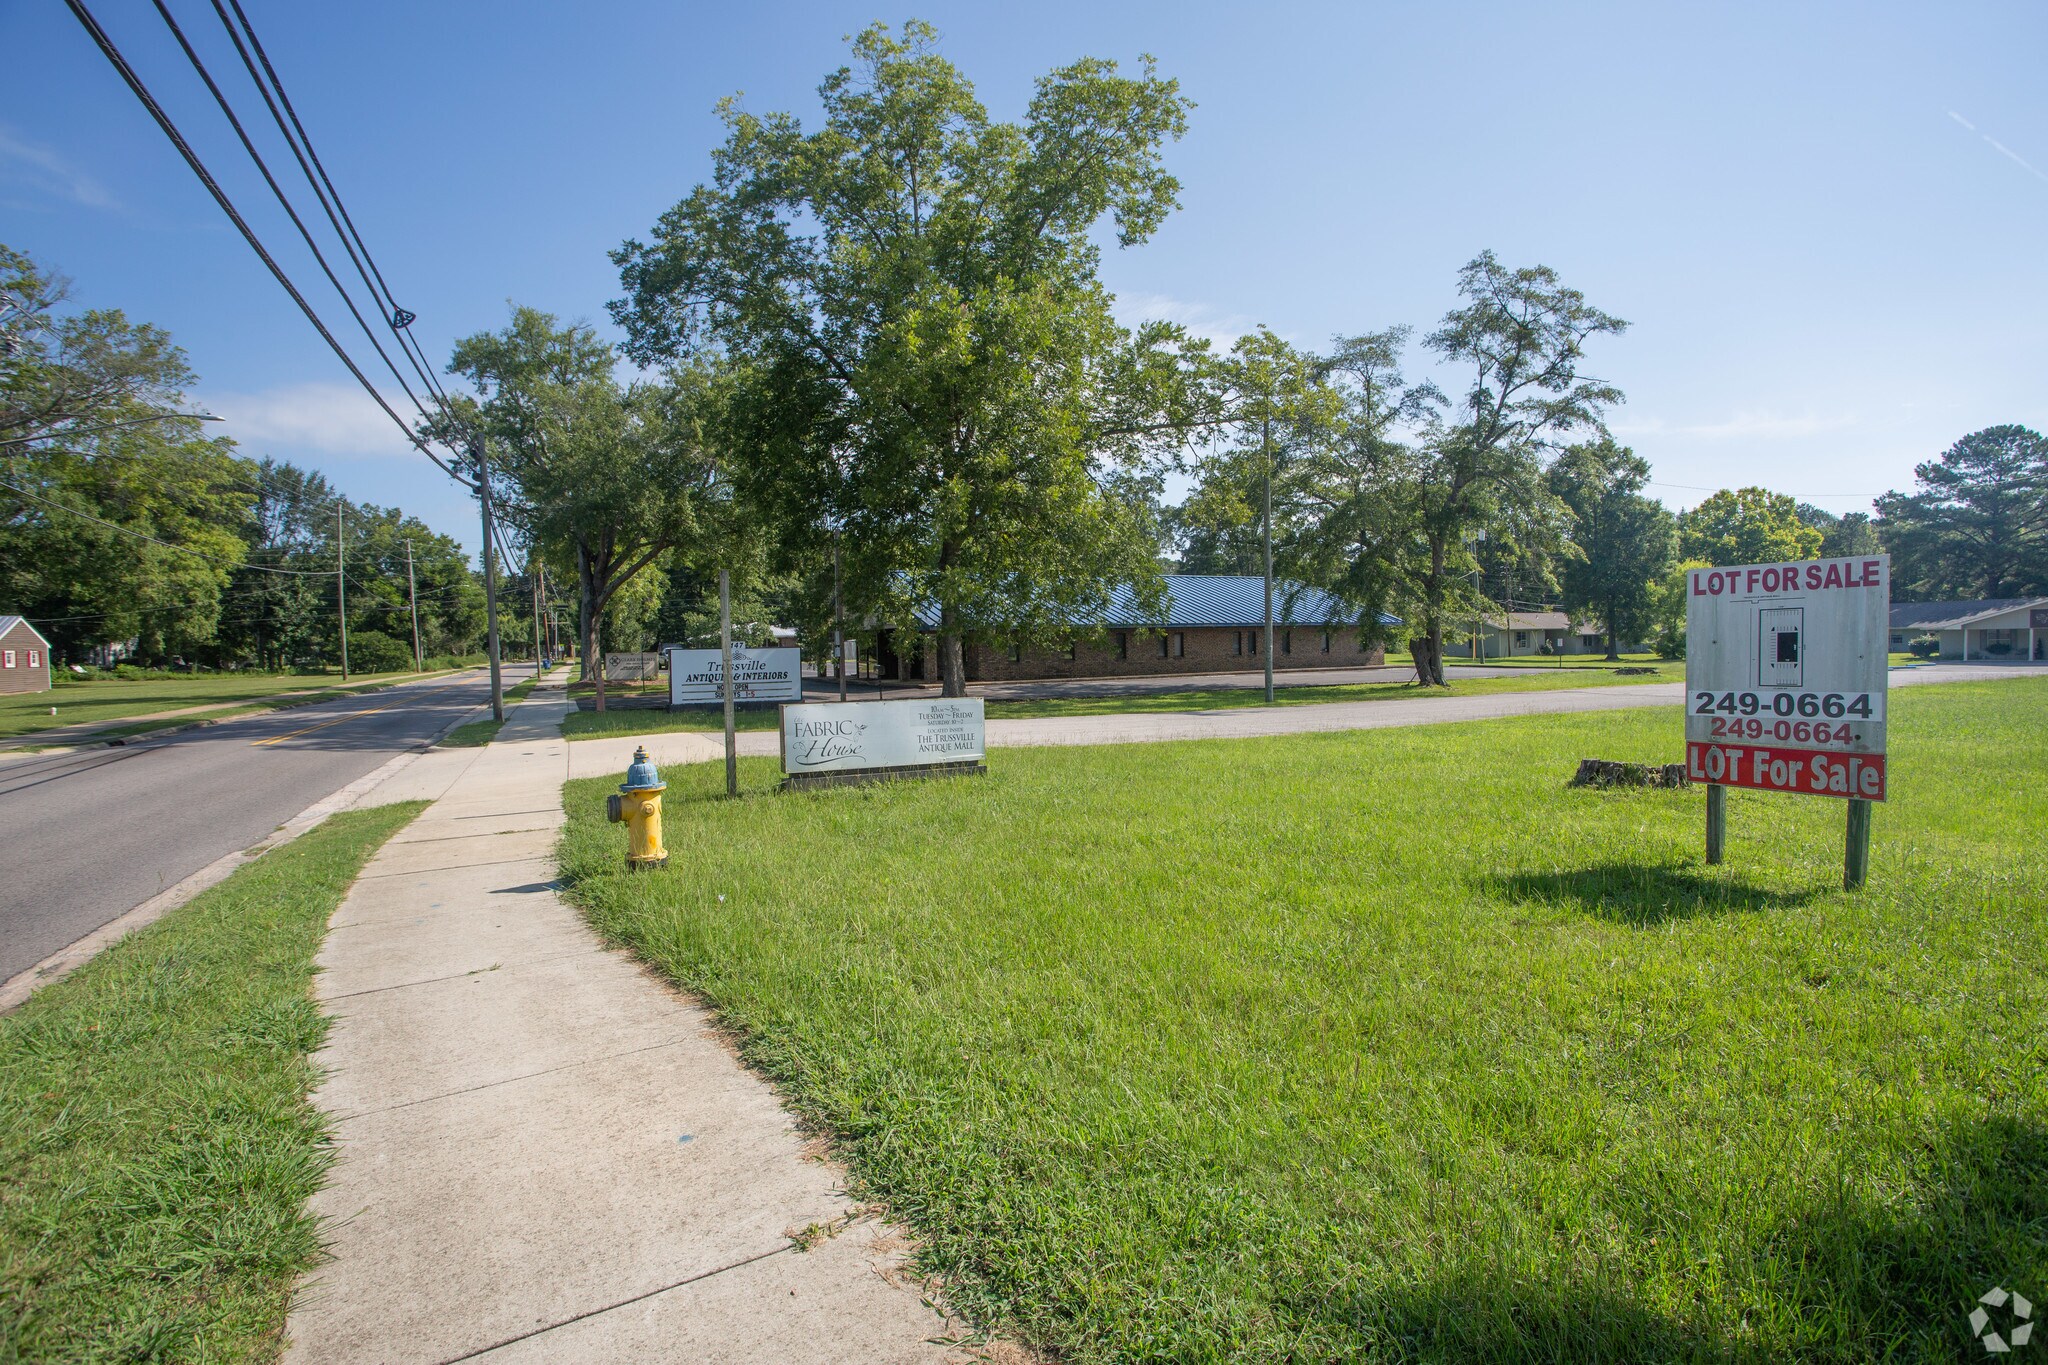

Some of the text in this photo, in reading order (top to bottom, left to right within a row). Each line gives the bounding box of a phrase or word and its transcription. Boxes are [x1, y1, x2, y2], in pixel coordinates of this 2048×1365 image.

[1693, 561, 1880, 596] LOT FOR SALE
[686, 673, 724, 683] ANTIQU
[742, 671, 788, 681] INTERIORS
[1695, 692, 1873, 719] 249-0664
[794, 720, 852, 738] FABRIC
[917, 733, 975, 744] THE TRUSSVILLE
[1710, 717, 1853, 745] 249-0664
[793, 736, 862, 758] House
[919, 742, 974, 753] ANTIQUE MALL
[1690, 746, 1879, 795] LOT For Sale
